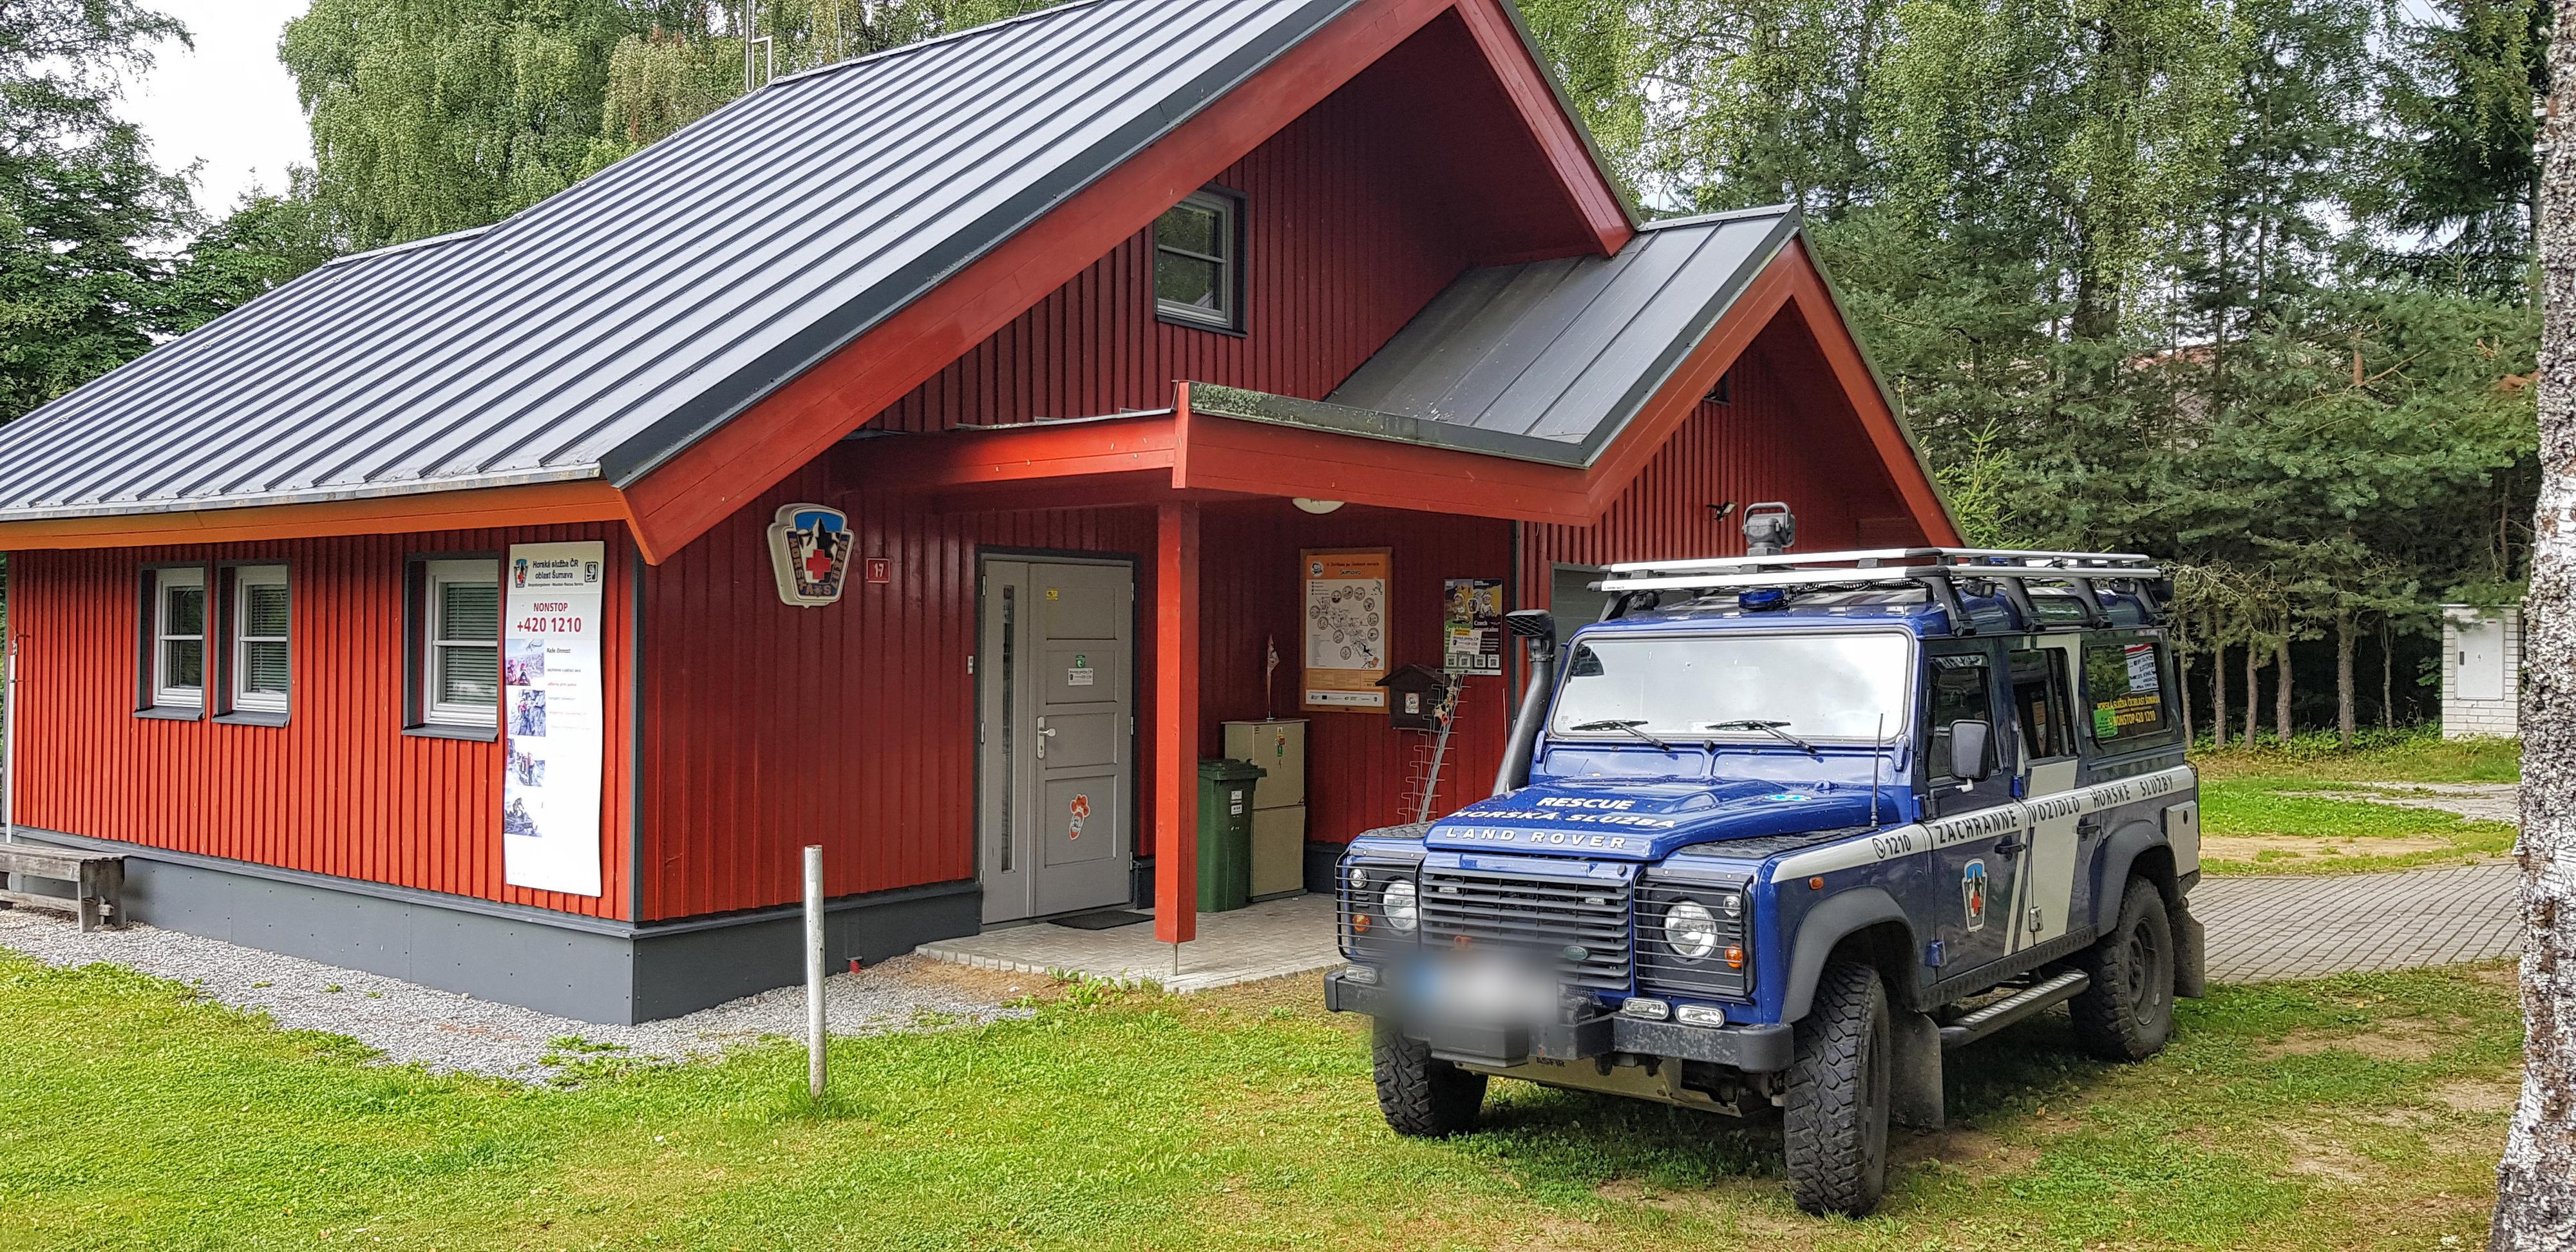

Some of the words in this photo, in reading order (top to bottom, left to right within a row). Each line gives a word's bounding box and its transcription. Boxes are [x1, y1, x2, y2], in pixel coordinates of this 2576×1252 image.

[570, 558, 578, 567] ČR
[552, 569, 573, 578] Šumava
[875, 563, 884, 577] 17
[533, 602, 568, 612] NONSTOP
[517, 617, 546, 632] +420
[551, 617, 581, 632] 1210
[2113, 713, 2135, 726] NONSTOP
[1536, 797, 1634, 810] RESCUE
[1450, 810, 1558, 820] HORSKÁ
[1566, 813, 1675, 828] SLUŽBA
[1887, 835, 1911, 855] 1210
[1937, 808, 2018, 843] ZÁCHRANNÉ
[2030, 797, 2081, 822] VOZIDLO
[2092, 781, 2130, 808] HORSKÉ
[2142, 775, 2174, 797] SLUŽBY
[1446, 828, 1515, 840] LAND
[1530, 831, 1627, 848] ROVER
